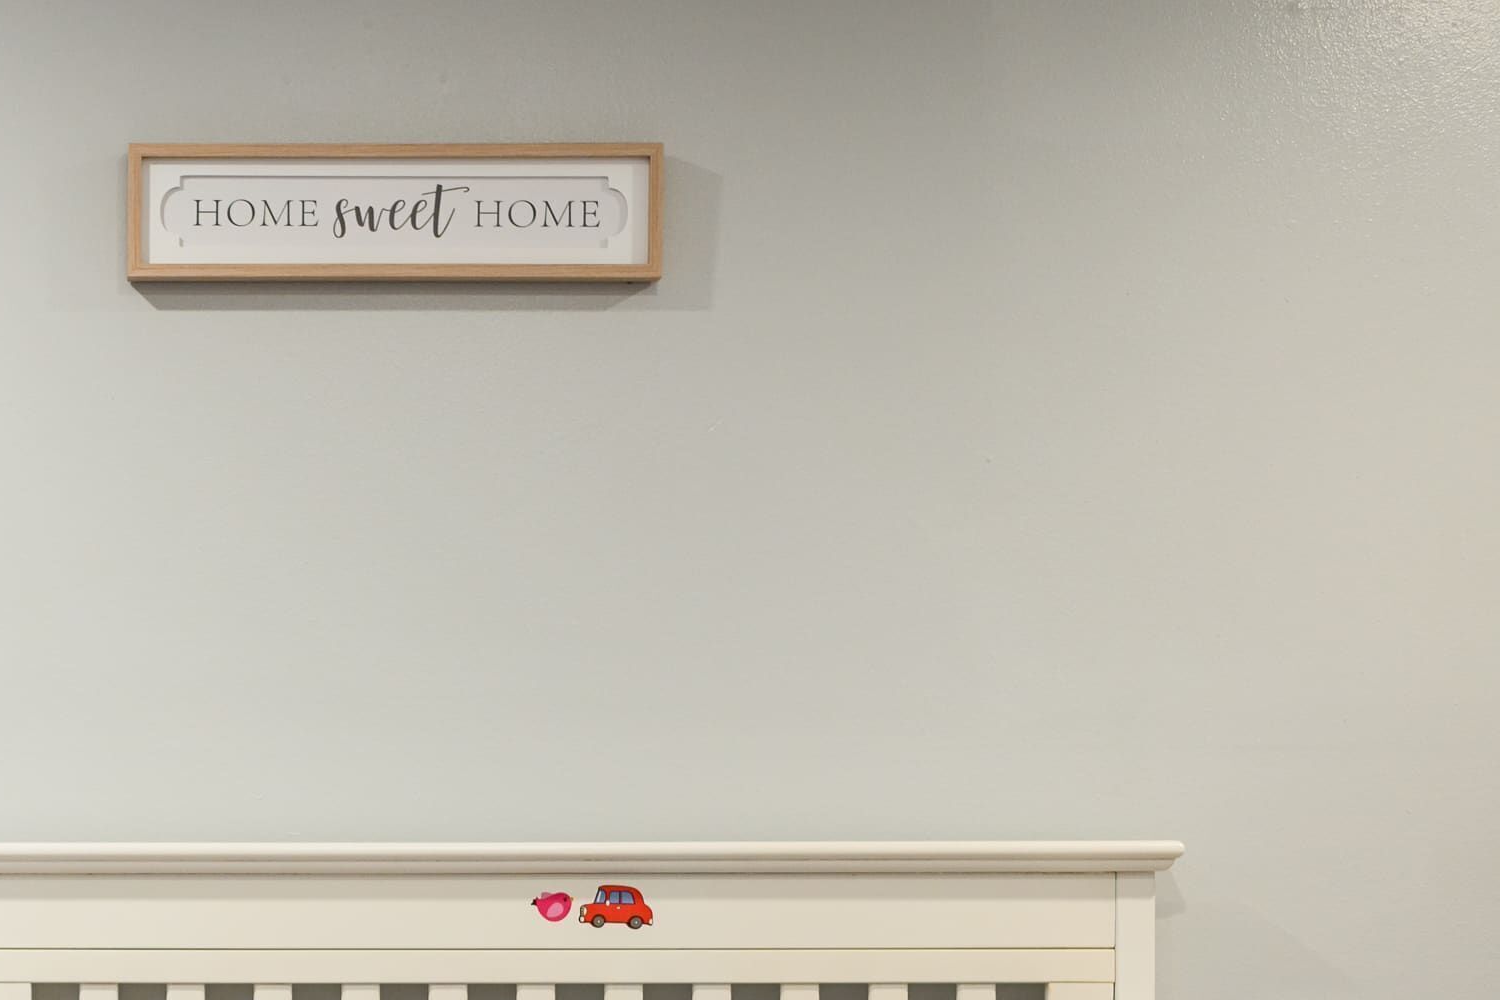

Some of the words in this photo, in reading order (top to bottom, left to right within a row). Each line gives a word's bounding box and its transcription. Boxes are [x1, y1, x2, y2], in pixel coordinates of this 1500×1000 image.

[192, 199, 318, 227] HOME
[333, 184, 470, 238] sweet
[475, 199, 601, 227] HOME
